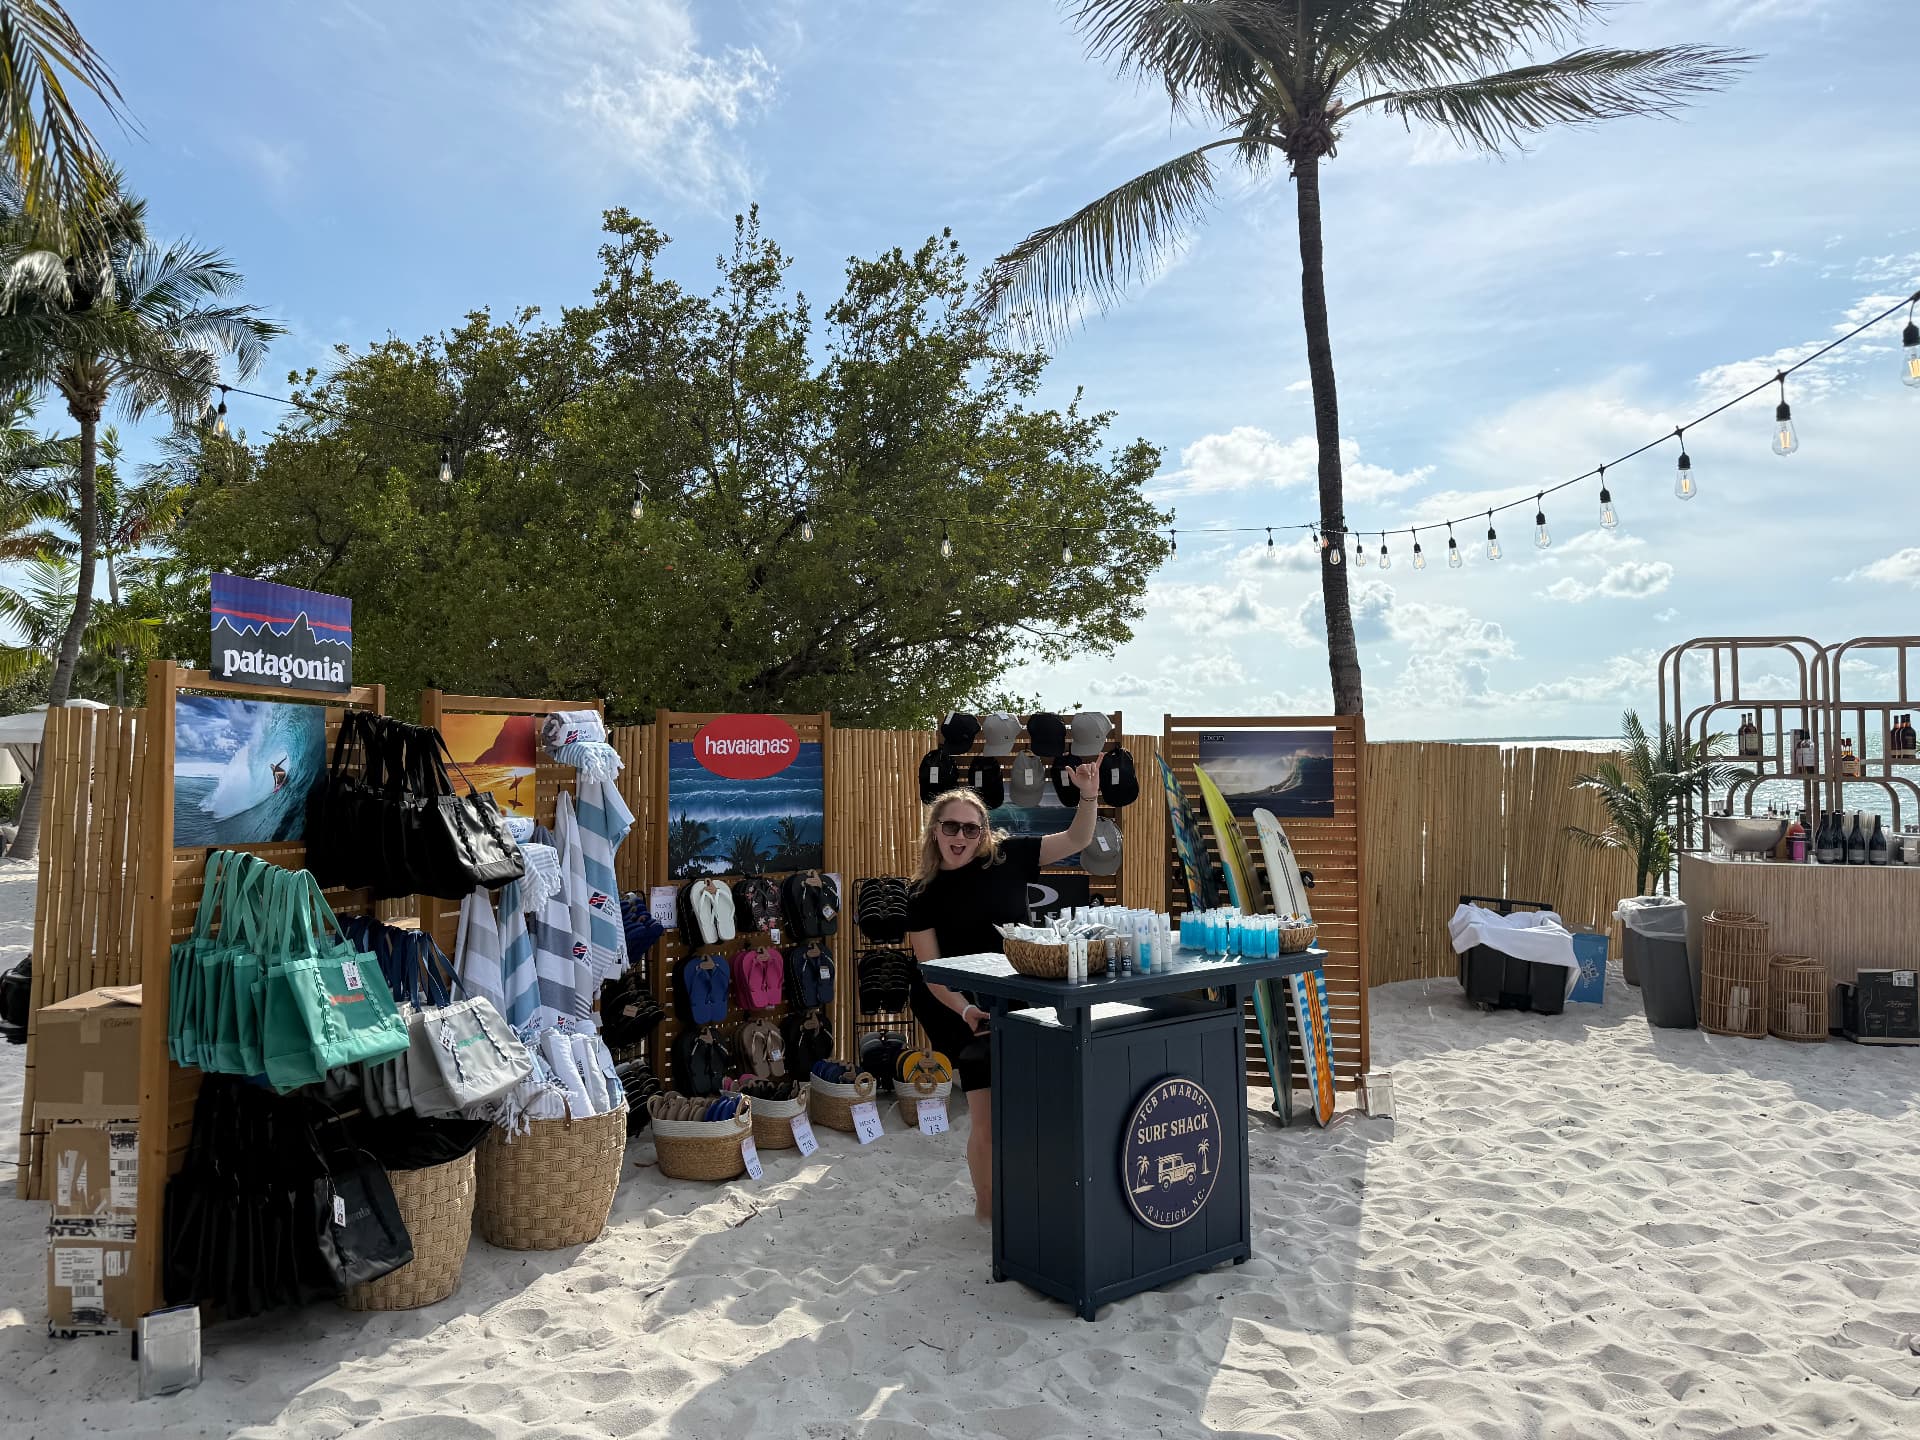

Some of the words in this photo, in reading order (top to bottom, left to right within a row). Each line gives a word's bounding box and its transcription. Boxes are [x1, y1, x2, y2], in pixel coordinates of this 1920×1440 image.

[223, 649, 345, 684] patagonia
[705, 735, 791, 756] havaianas
[1139, 1095, 1159, 1122] FCB
[866, 1126, 874, 1138] 8
[929, 1124, 940, 1135] 13
[1137, 1122, 1169, 1145] SURF
[1170, 1112, 1209, 1137] SHACK
[1191, 1191, 1205, 1207] NC
